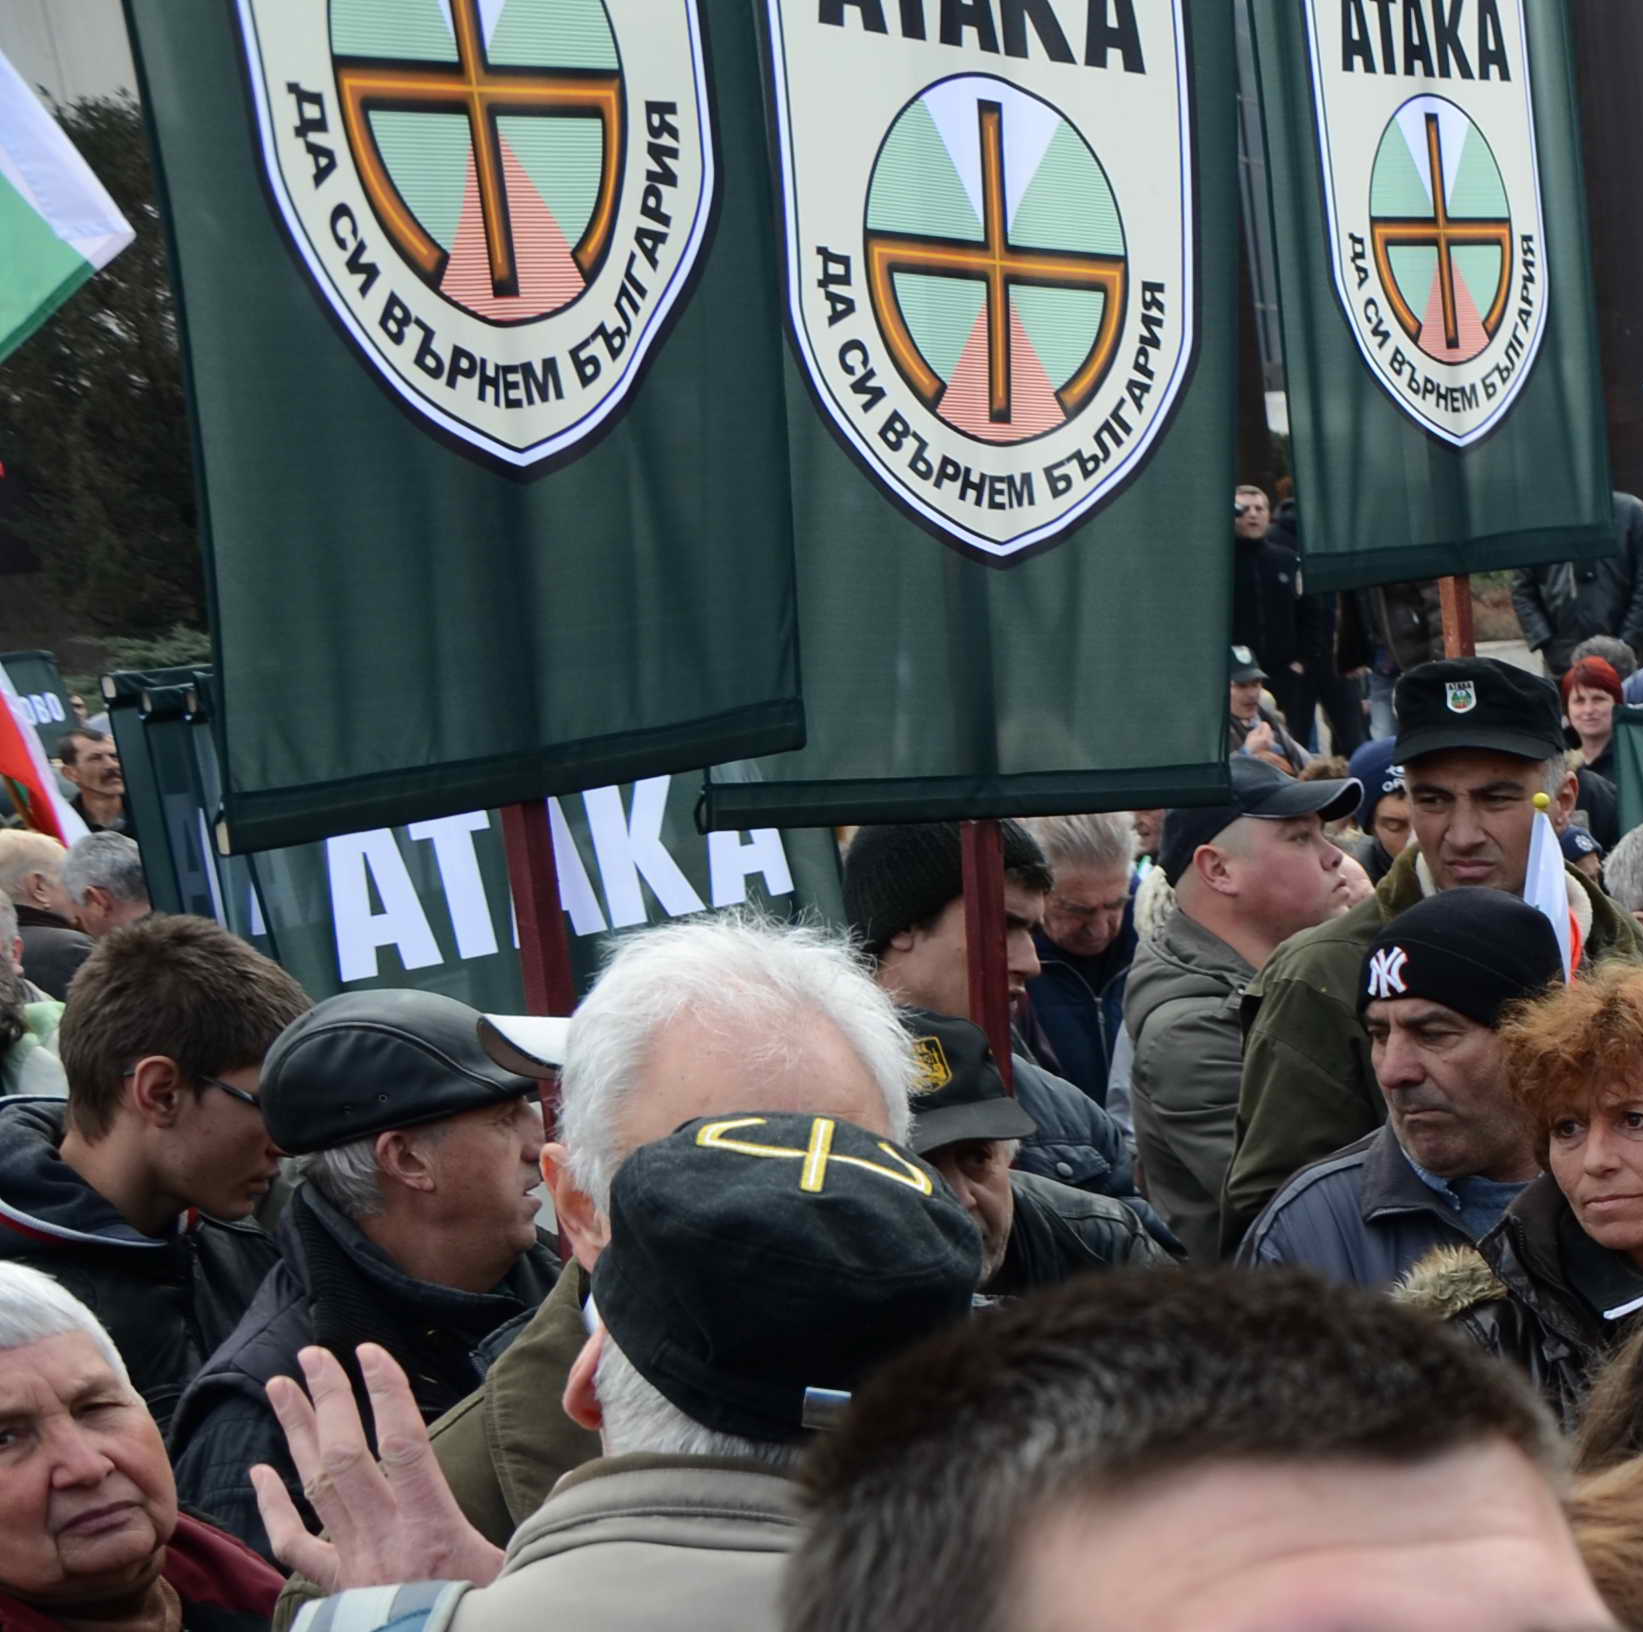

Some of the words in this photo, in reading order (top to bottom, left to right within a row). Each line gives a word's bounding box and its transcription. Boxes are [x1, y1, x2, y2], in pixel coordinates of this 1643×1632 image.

[1341, 0, 1511, 82] АТАКА
[286, 82, 338, 190] ДА
[330, 203, 381, 298] СИ
[378, 290, 565, 409] ВЪРНЕМ
[568, 100, 680, 389] БЪЛГАРИЯ
[1348, 232, 1366, 290] ДА
[1363, 298, 1391, 350] СИ
[1389, 351, 1480, 413] ВЪРНЕМ
[1480, 234, 1536, 402] БЪЛГАРИЯ
[816, 246, 856, 327] ДА
[838, 339, 887, 413] СИ
[878, 409, 1035, 510] ВЪРНЕМ
[1043, 280, 1165, 499] БЪЛГАРИЯ
